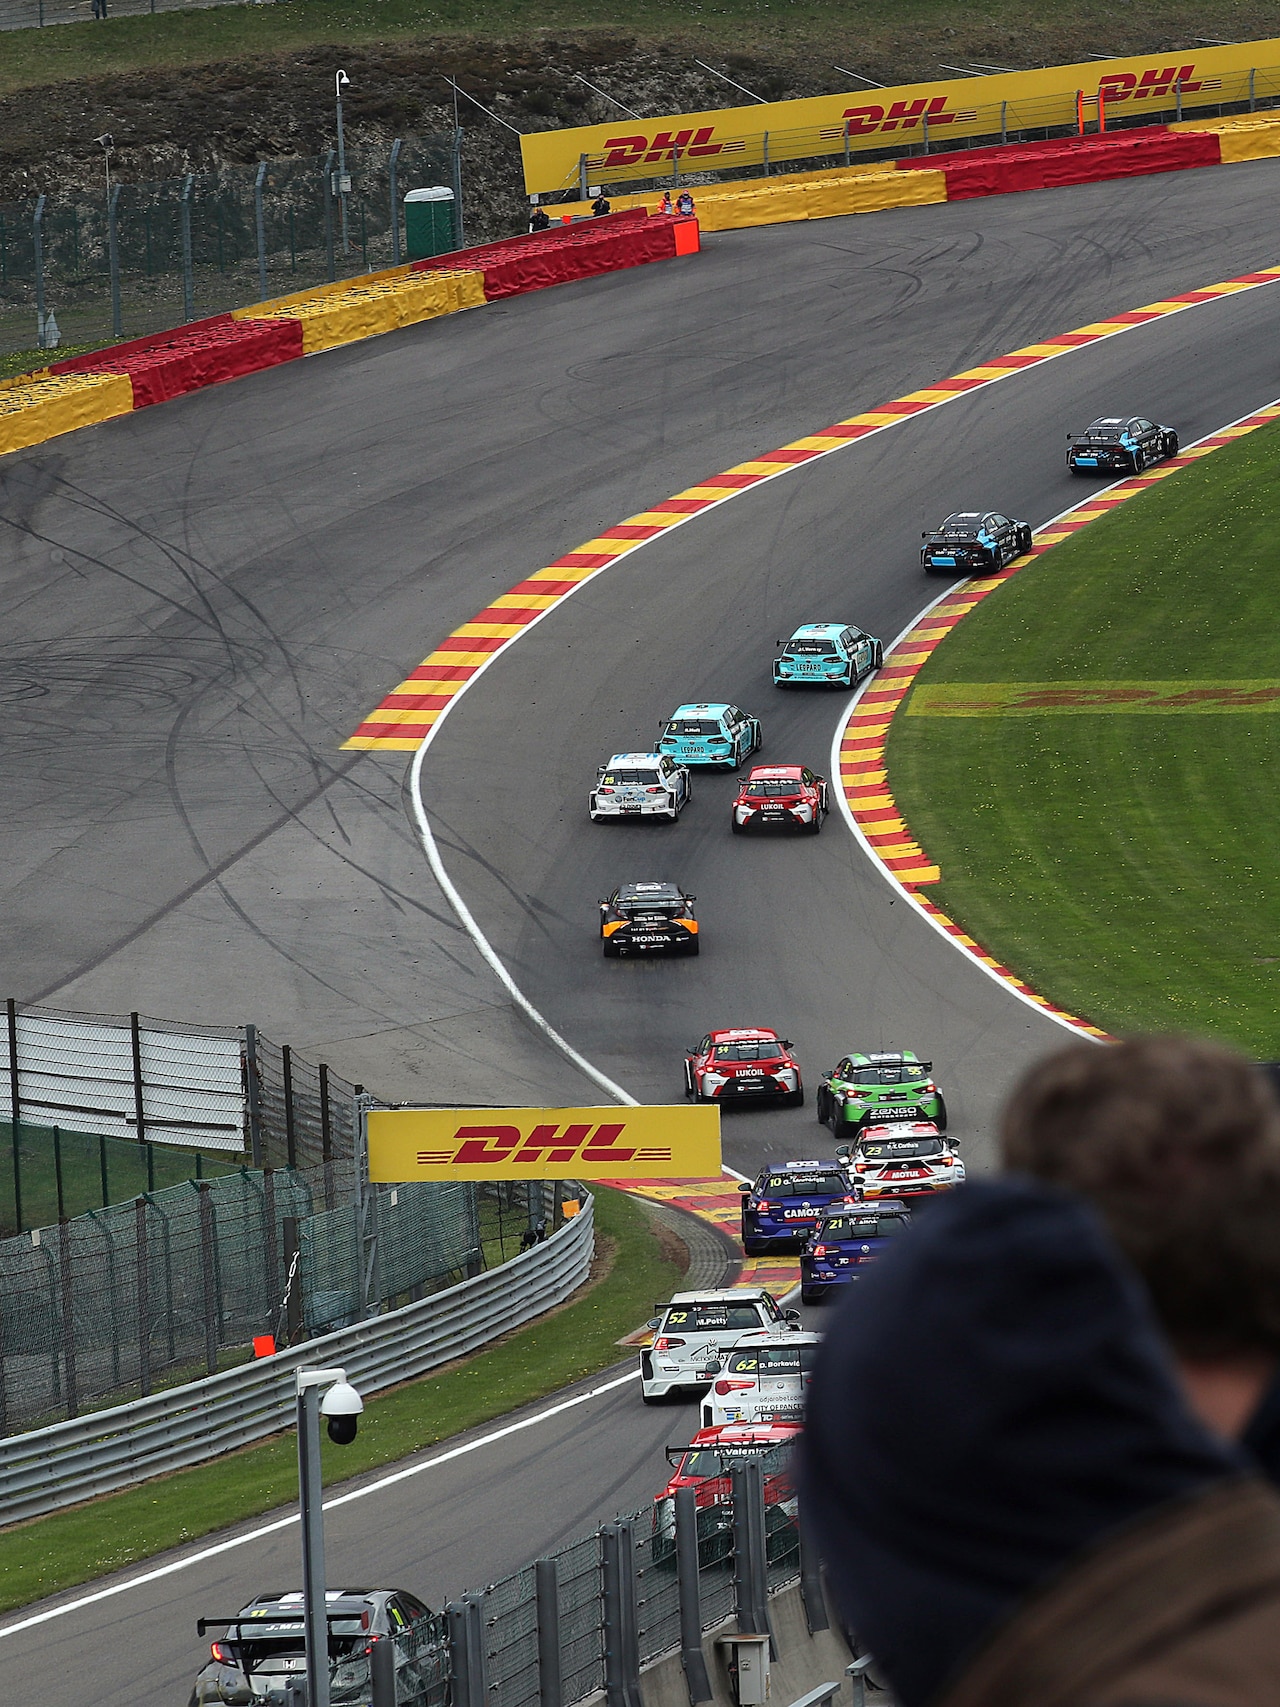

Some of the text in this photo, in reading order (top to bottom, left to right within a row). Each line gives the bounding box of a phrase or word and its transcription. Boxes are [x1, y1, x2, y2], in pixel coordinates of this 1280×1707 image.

[1098, 64, 1202, 101] DHL
[842, 96, 956, 137] DHL
[603, 127, 724, 167] DHL
[670, 723, 678, 731] 3
[681, 746, 704, 754] LEOPARD
[604, 776, 615, 785] 25
[632, 935, 671, 943] HONDA
[718, 1046, 729, 1054] 54
[735, 1068, 765, 1077] LUKOIL
[907, 1066, 922, 1076] 55
[450, 1123, 638, 1165] DHL
[865, 1146, 882, 1156] 23
[891, 1171, 920, 1179] MOTUL
[770, 1177, 782, 1187] 10
[784, 1207, 823, 1219] CAMOZ
[829, 1218, 843, 1230] 21
[668, 1312, 688, 1324] 52
[735, 1359, 757, 1371] 62
[688, 1452, 699, 1465] 7
